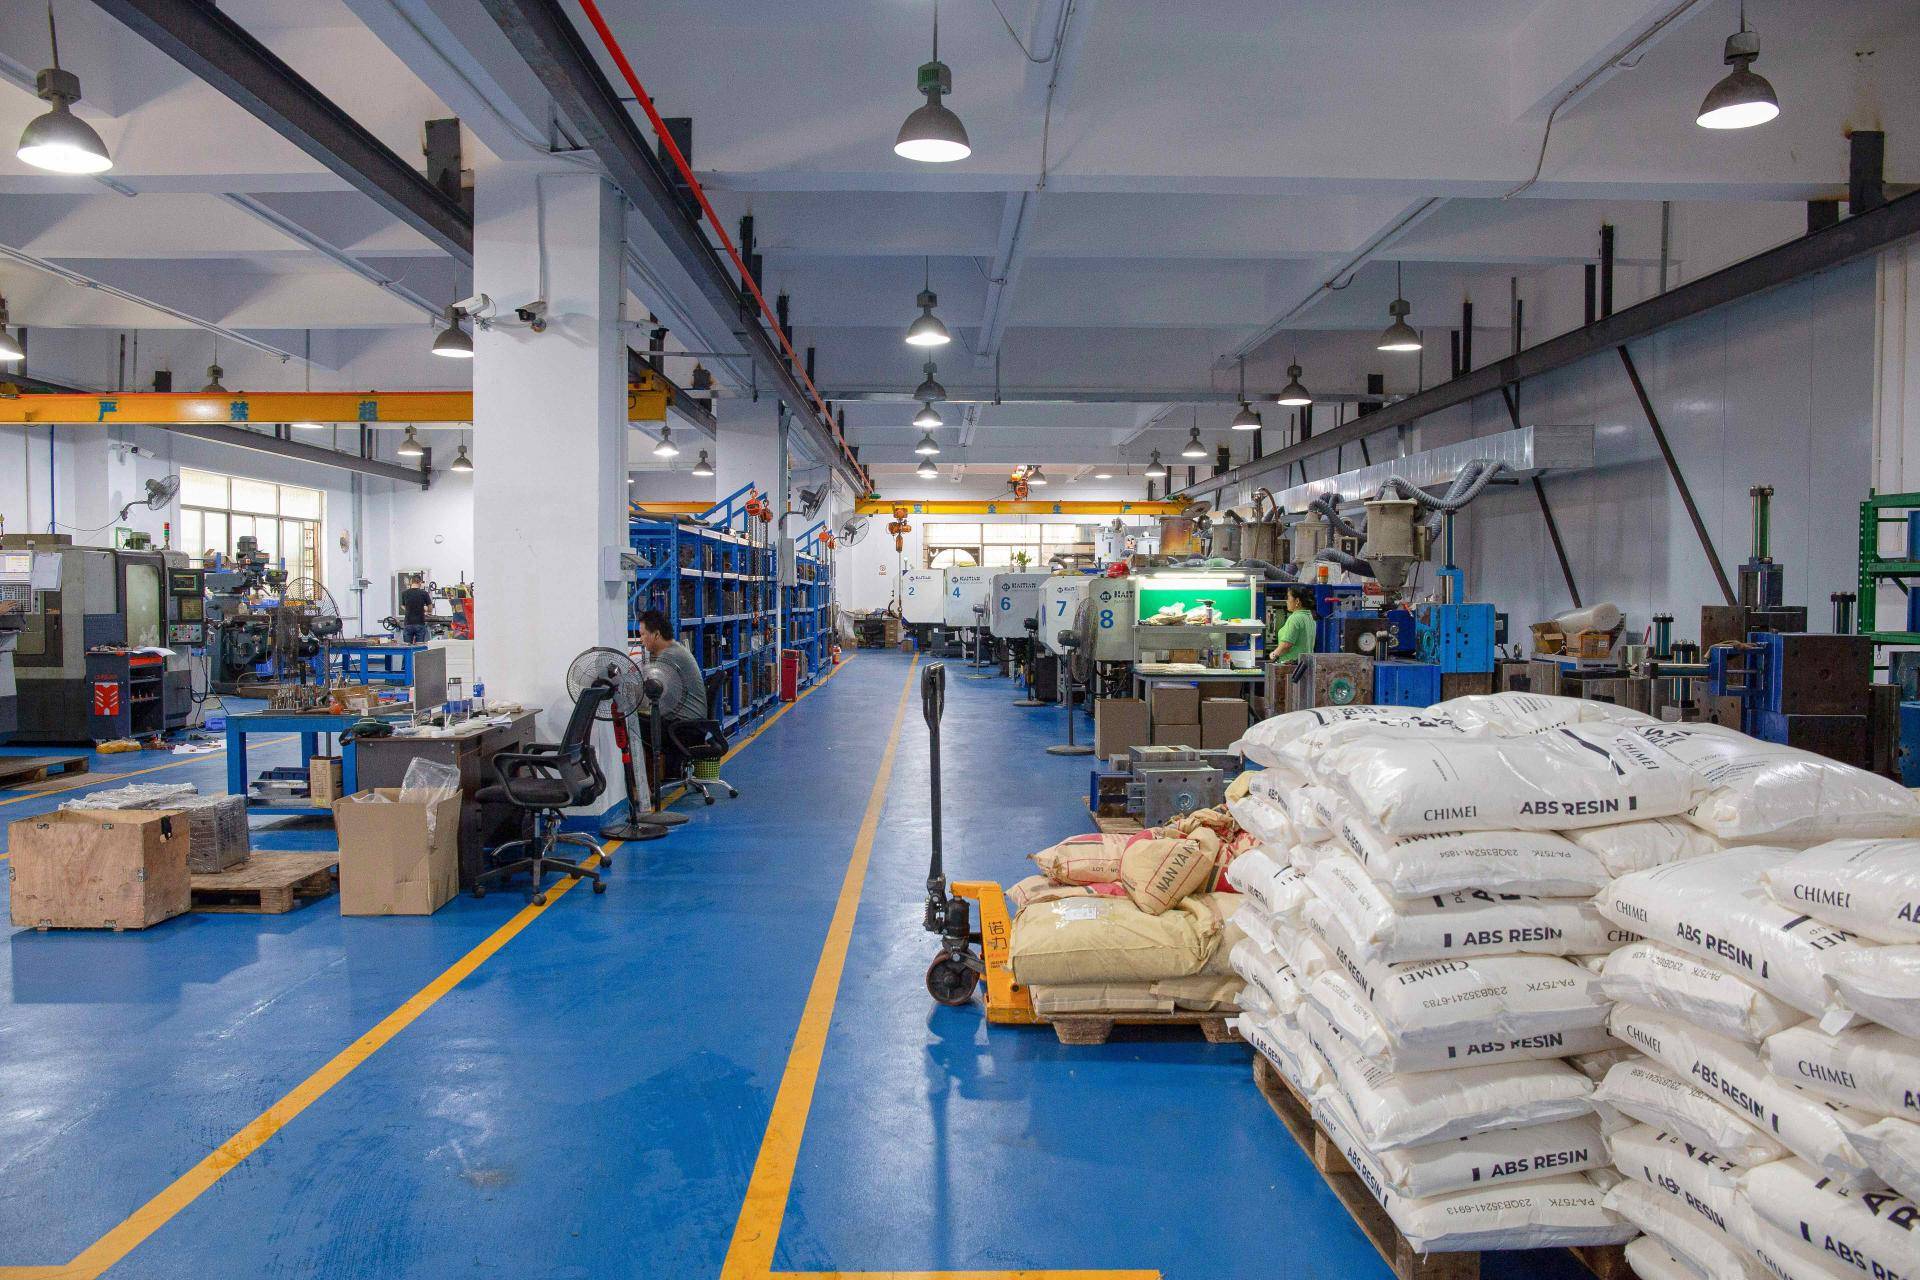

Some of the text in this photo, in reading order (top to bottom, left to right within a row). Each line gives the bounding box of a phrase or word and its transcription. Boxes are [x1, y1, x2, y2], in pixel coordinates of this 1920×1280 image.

[908, 586, 916, 596] 2
[952, 587, 961, 598] 4
[1000, 596, 1011, 611] 6
[1056, 600, 1067, 617] 7
[1100, 609, 1114, 629] 8
[1616, 738, 1660, 770] CHIMEI
[1424, 805, 1477, 821] CHIMEI
[1520, 798, 1619, 815] ABS RESIN
[1156, 853, 1189, 893] NAN YA
[1793, 884, 1851, 908] CHIMEI
[1616, 900, 1648, 923] CHIMEI
[988, 921, 1008, 950] 诺力
[1464, 927, 1563, 946] ABS RESIN
[1677, 922, 1701, 945] ABS
[1706, 933, 1753, 970] RESIN
[1347, 959, 1368, 993] RESIN
[1399, 960, 1470, 986] CHIMEI
[1526, 979, 1576, 993] PA-757K
[1467, 1032, 1563, 1056] ABS RESIN
[1626, 1024, 1661, 1054] CHIMEI
[1798, 1060, 1857, 1089] CHIMEI
[1692, 1060, 1719, 1088] ABS
[1721, 1078, 1764, 1121] RESIN
[1347, 1147, 1383, 1198] ABS RESIN
[1491, 1149, 1588, 1178] ABS RESIN
[1549, 1198, 1595, 1207] PA-757K
[1658, 1174, 1727, 1233] AB RESIN
[1825, 1235, 1867, 1271] ABS
